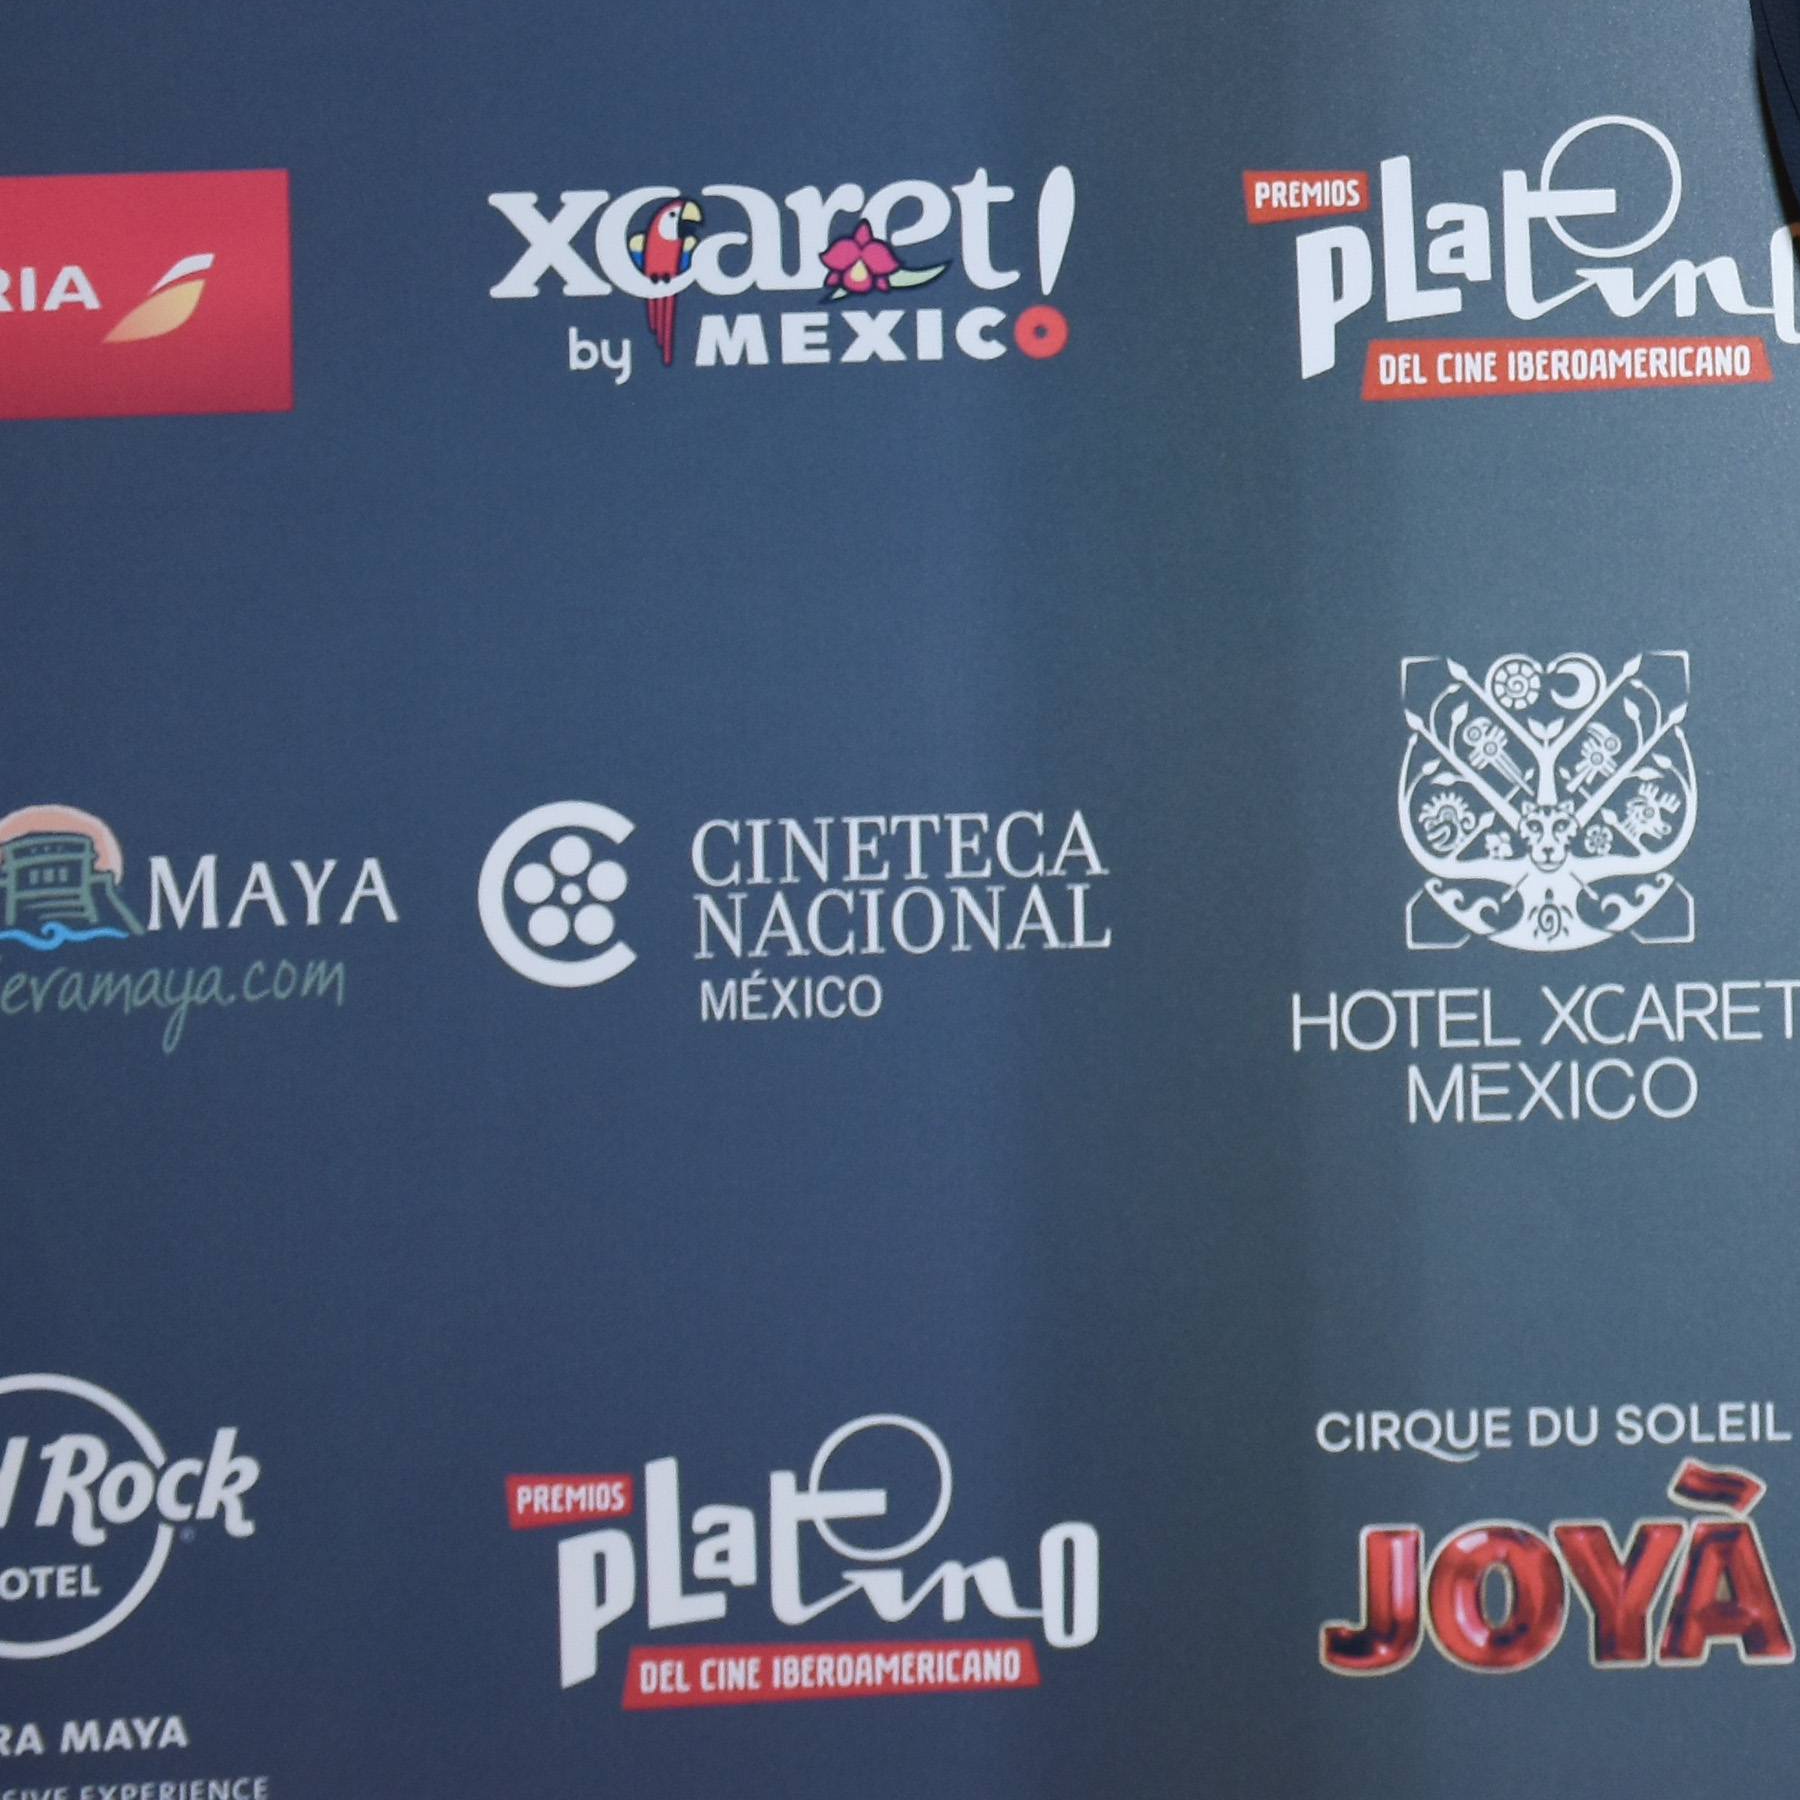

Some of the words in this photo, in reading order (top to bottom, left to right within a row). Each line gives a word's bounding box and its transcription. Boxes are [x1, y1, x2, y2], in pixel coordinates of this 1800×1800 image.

[1255, 179, 1360, 208] PREMIOS
[569, 327, 631, 384] by
[694, 305, 1068, 367] MEXICO
[1379, 354, 1427, 384] DEL
[1437, 352, 1497, 383] CINE
[1509, 345, 1750, 381] IBEROAMERICANO
[692, 811, 1108, 886] CINETECA
[148, 855, 397, 930] MAYA
[695, 884, 1111, 958] NACIONAL
[701, 970, 882, 1020] MÉXICO
[1293, 988, 1521, 1051] HOTEL
[1408, 1057, 1698, 1123] MEXICO
[1316, 1408, 1511, 1462] CIRQUE
[1529, 1407, 1598, 1446] DU
[1617, 1403, 1791, 1444] SOLEIL
[36, 1428, 259, 1546] Rock
[517, 1482, 624, 1513] PREMIOS
[0, 1565, 101, 1600] OTEL
[641, 1661, 689, 1693] DEL
[701, 1658, 759, 1691] CINE
[773, 1649, 1020, 1688] IBEROAMERICANO
[61, 1717, 187, 1752] MAYA
